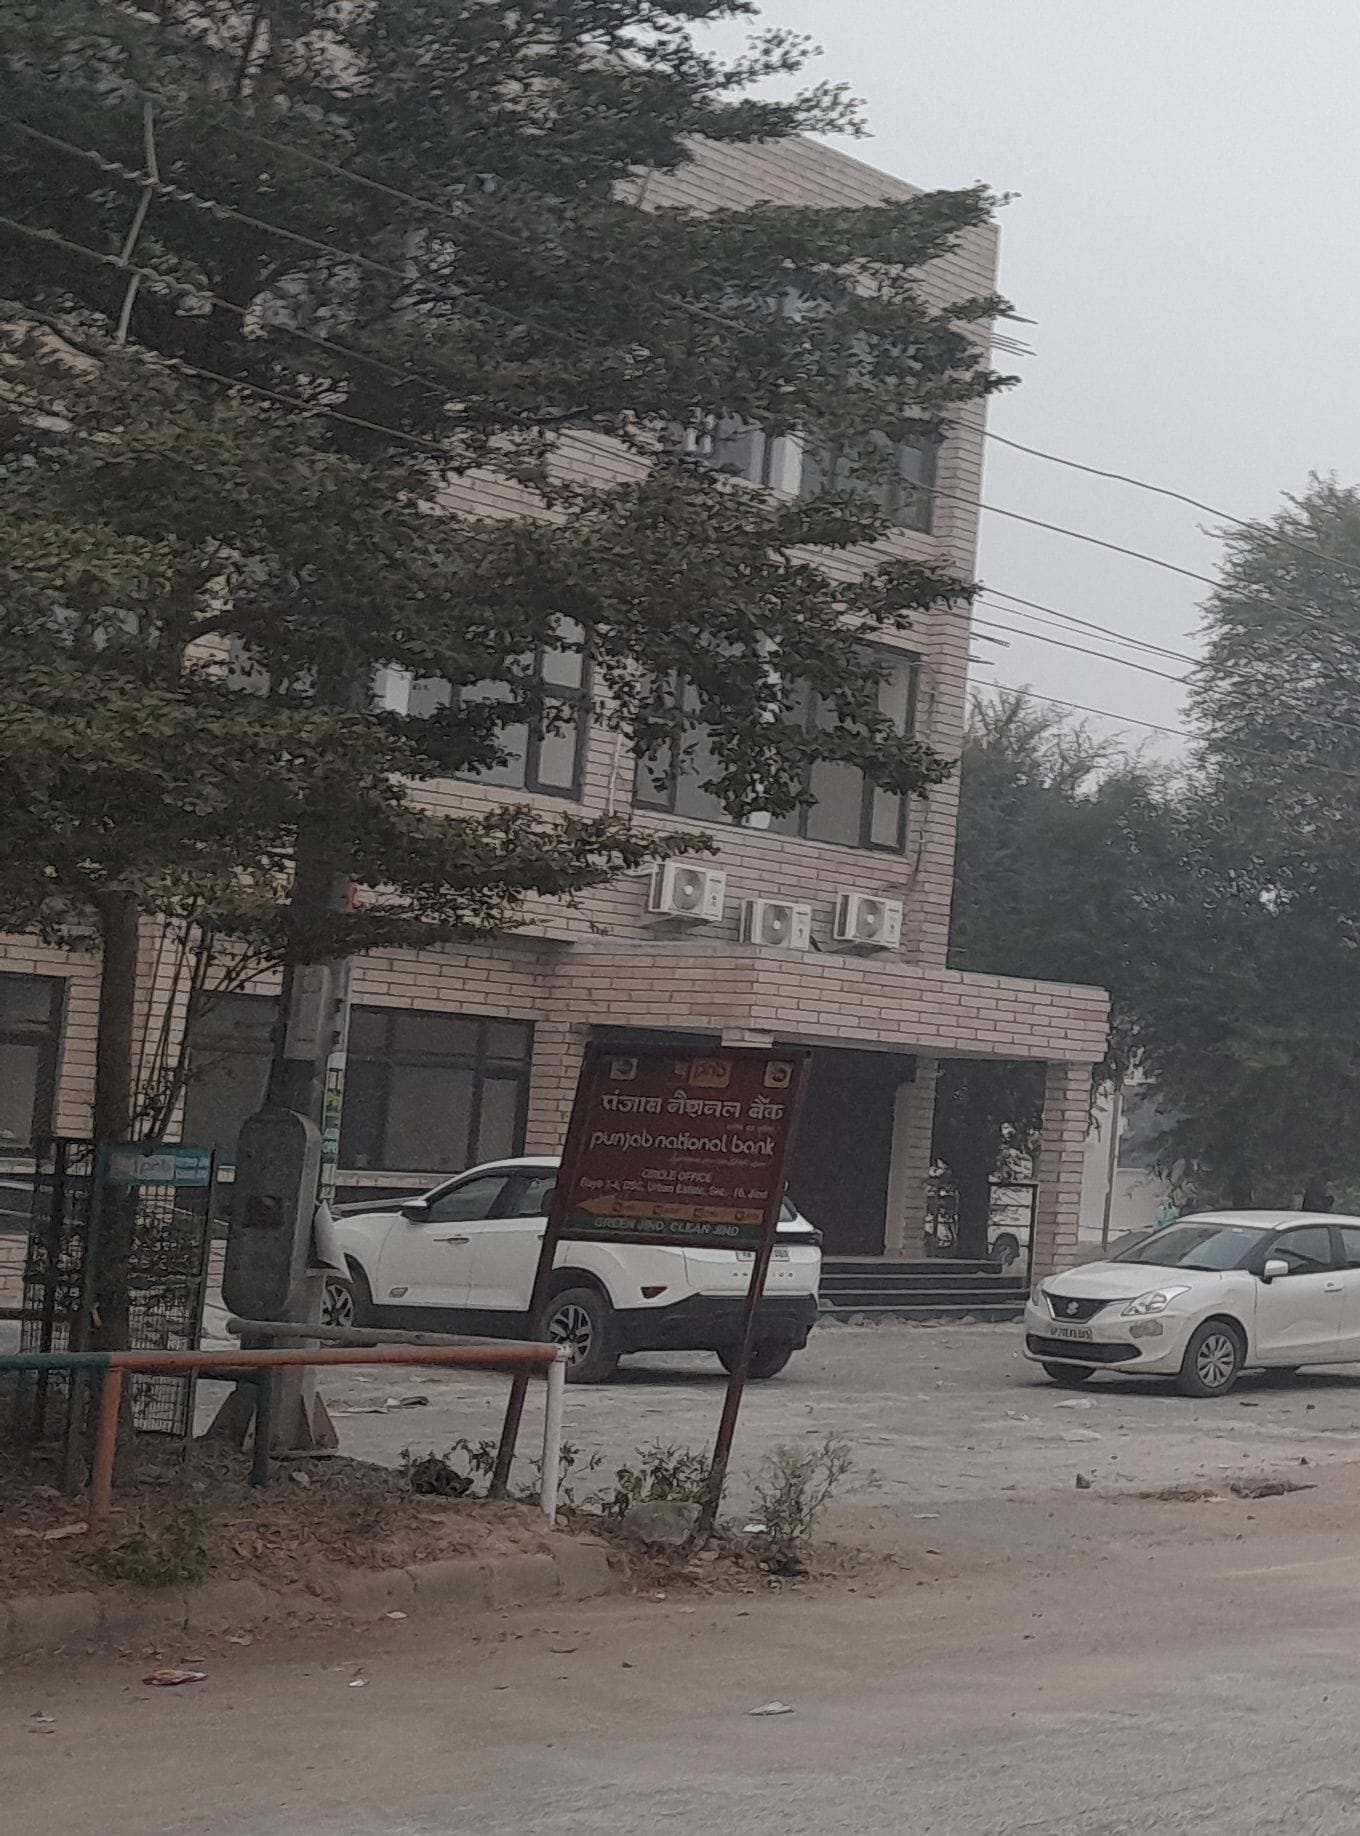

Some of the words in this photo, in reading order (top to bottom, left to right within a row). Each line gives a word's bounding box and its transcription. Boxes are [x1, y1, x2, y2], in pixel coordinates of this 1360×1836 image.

[667, 1089, 742, 1119] नैशनल
[748, 1094, 786, 1121] बैंक
[589, 1127, 654, 1150] punjab
[656, 1131, 728, 1154] national
[731, 1134, 776, 1157] bank
[640, 1167, 676, 1181] CIRCLE
[678, 1171, 712, 1184] OFFICE
[594, 1217, 635, 1229] GREEN
[669, 1221, 710, 1234] CLEAN
[712, 1224, 740, 1236] JIND
